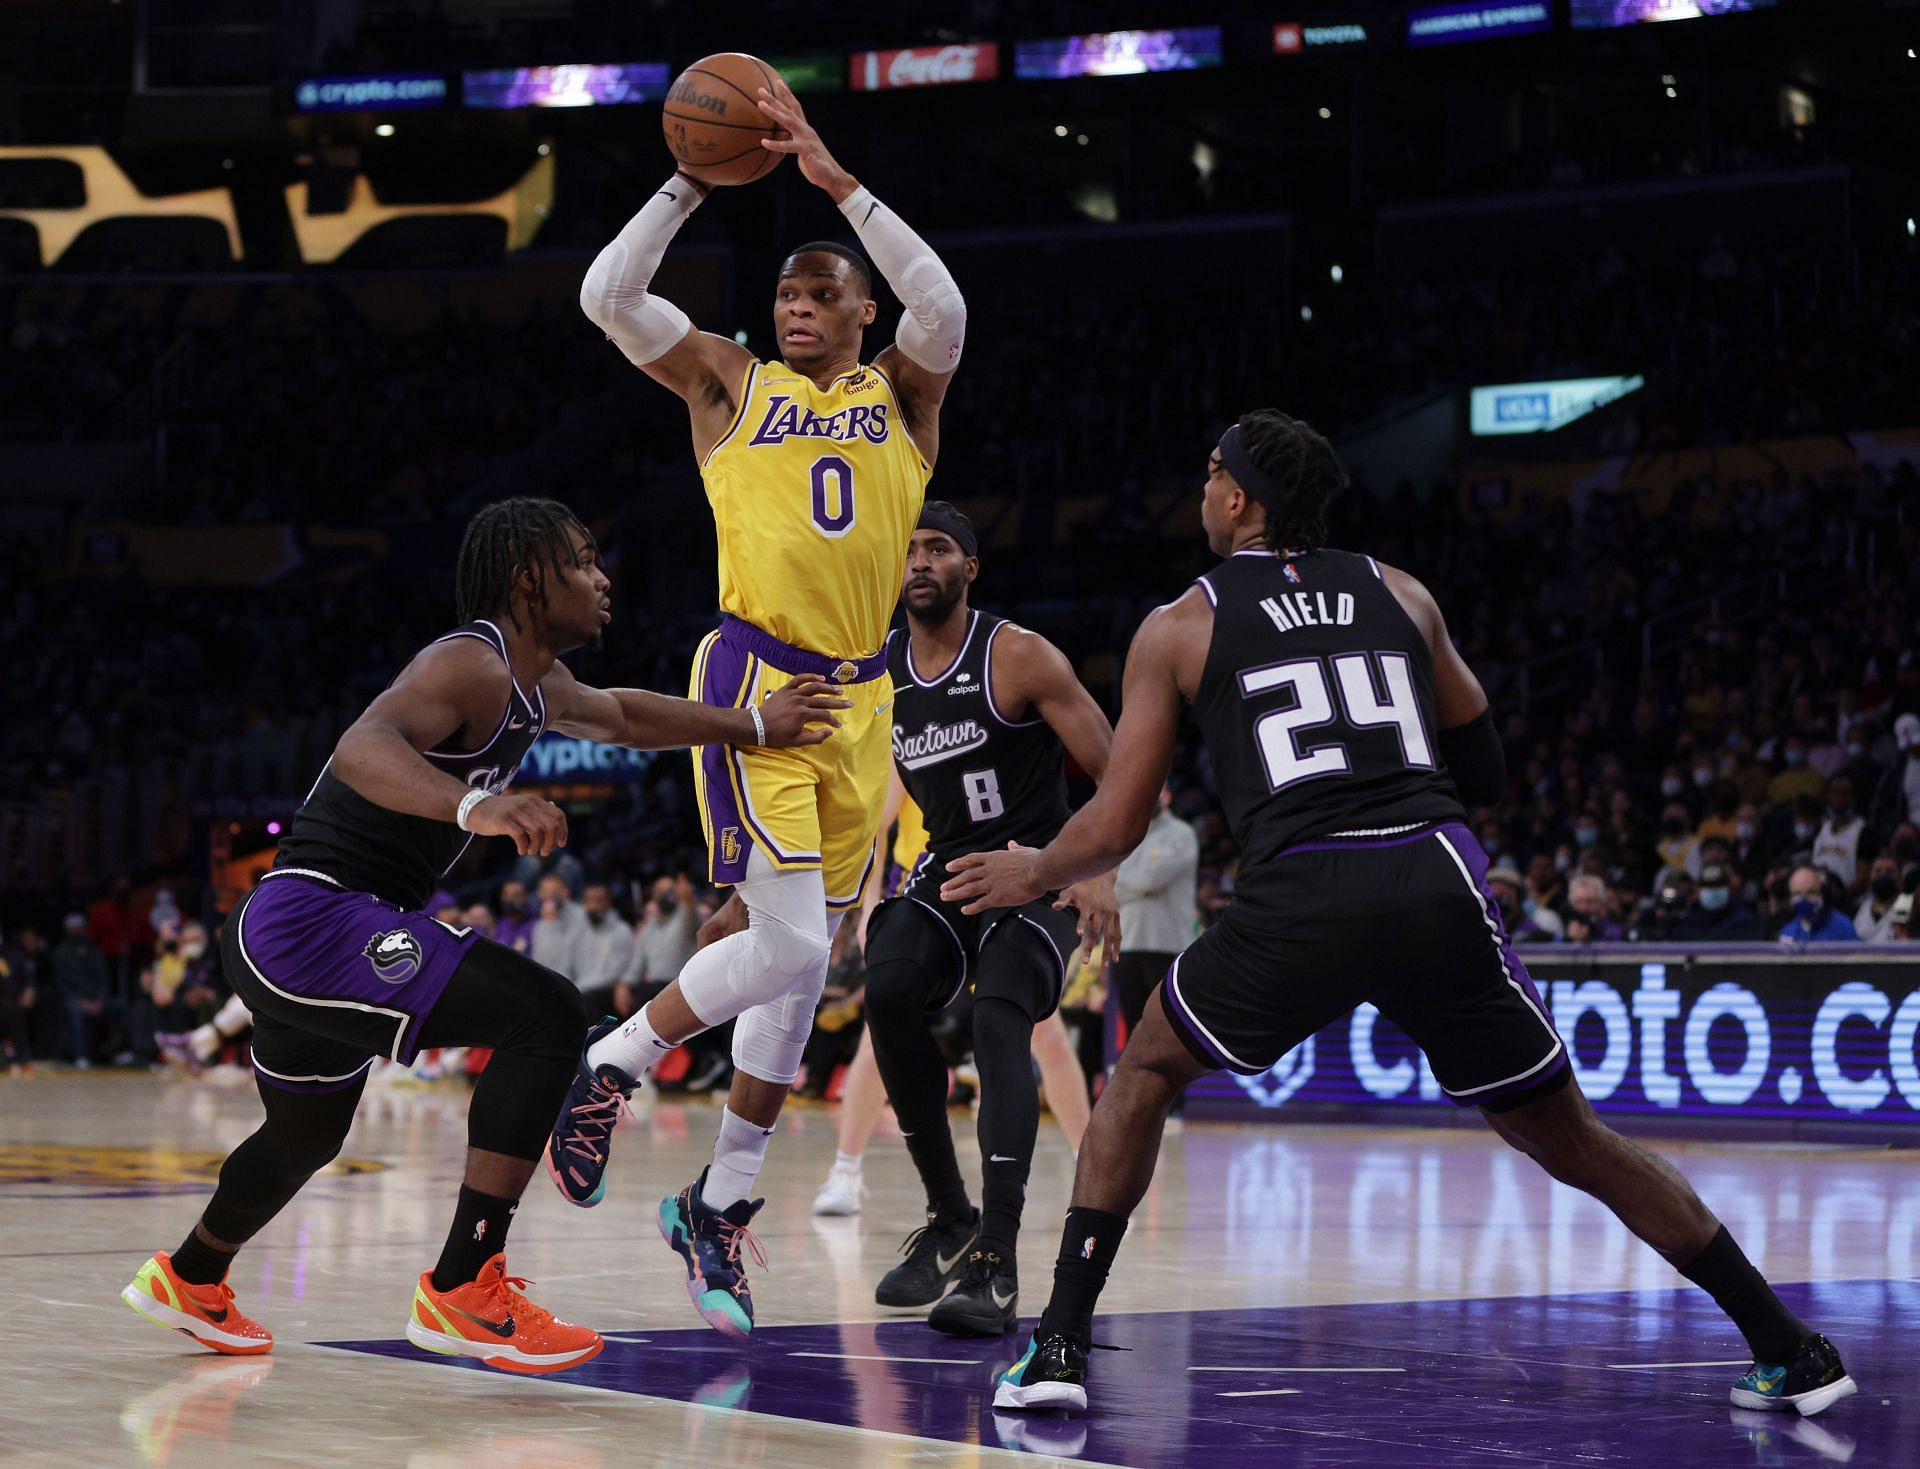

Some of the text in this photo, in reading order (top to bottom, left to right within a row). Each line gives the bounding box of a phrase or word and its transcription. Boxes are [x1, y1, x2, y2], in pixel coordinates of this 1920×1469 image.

[1304, 24, 1367, 45] TOYOTA
[320, 79, 446, 105] crypto.com
[846, 377, 879, 396] bibigo
[748, 395, 889, 447] LAKERS
[809, 455, 856, 538] 0
[1259, 591, 1355, 632] HIELD
[947, 683, 980, 695] dialpad
[891, 720, 988, 765] Sactown
[1236, 651, 1437, 794] 24
[963, 768, 1004, 822] 8
